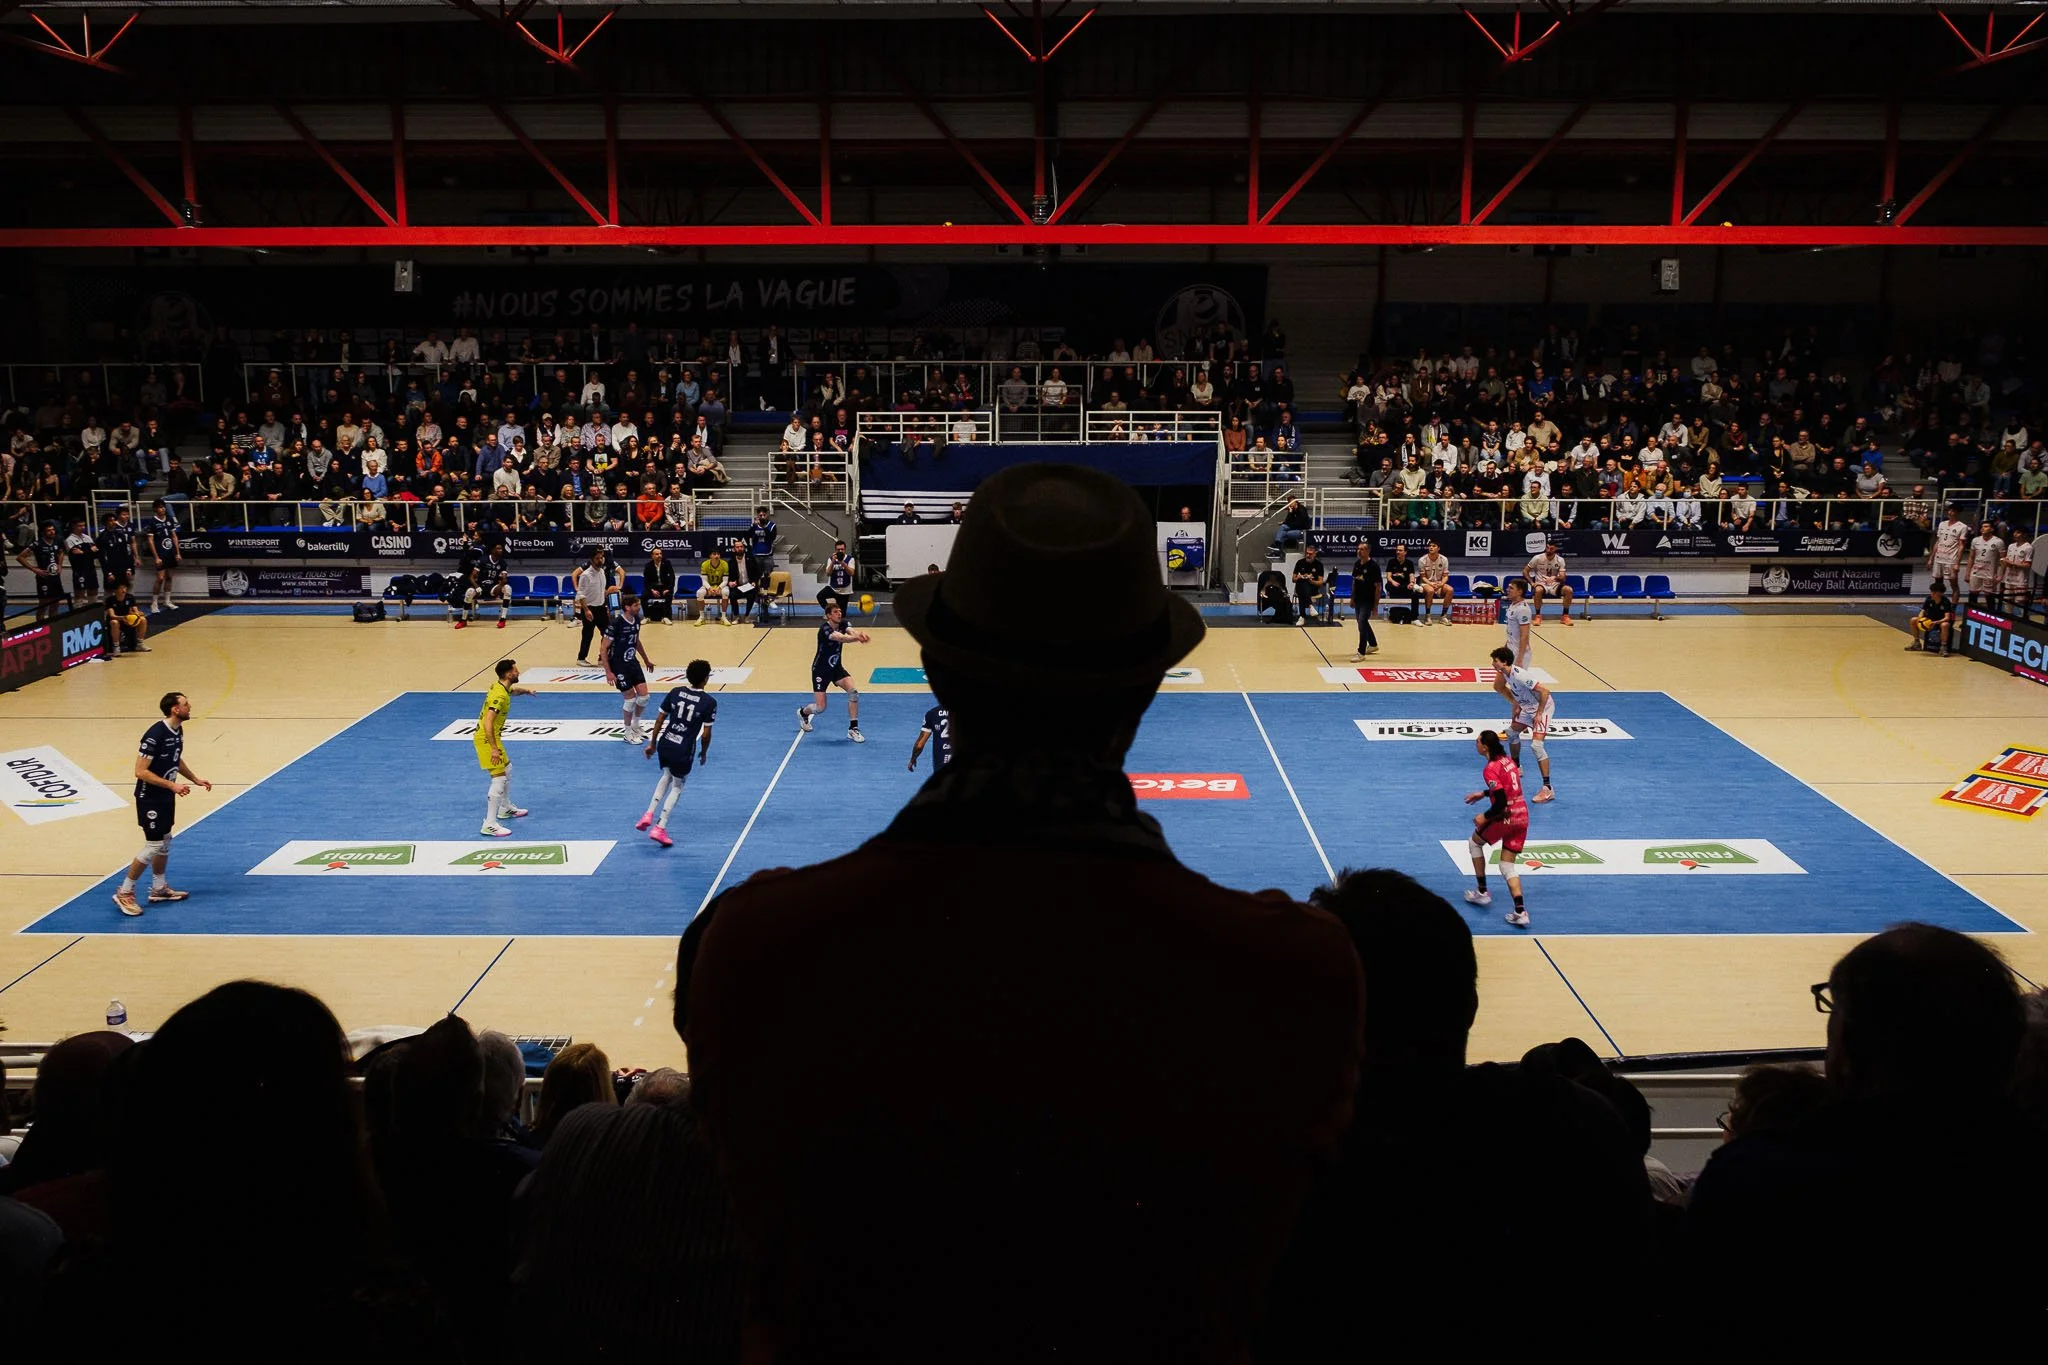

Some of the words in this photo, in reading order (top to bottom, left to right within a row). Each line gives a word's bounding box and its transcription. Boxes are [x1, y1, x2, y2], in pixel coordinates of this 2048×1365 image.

[452, 288, 558, 319] #NOUS
[567, 282, 695, 314] SOMMES
[705, 278, 745, 313] LA
[758, 275, 858, 311] VAGUE
[371, 536, 412, 549] CASINO
[655, 539, 692, 548] GESTAL
[1313, 535, 1368, 543] WIKLOG
[1390, 538, 1431, 546] FIDUCIA
[1601, 533, 1630, 549] WL
[307, 541, 350, 553] bakertilly
[1813, 569, 1838, 579] Saint
[1842, 569, 1881, 579] Nazaire
[1791, 579, 1823, 591] Volley
[1826, 579, 1845, 590] Ball
[1847, 579, 1900, 591] Atlantique
[62, 619, 103, 657] RMC
[1965, 618, 2048, 671] TELEC
[677, 701, 695, 722] 11
[1379, 724, 1474, 735] Cargill
[6, 757, 78, 798] COFIDUR
[1129, 779, 1237, 792] Betc
[321, 851, 405, 861] FRUIDIS
[473, 851, 556, 861] FRUIDIS
[1516, 850, 1582, 861] FRUID
[1654, 850, 1735, 861] FRUIDIS
